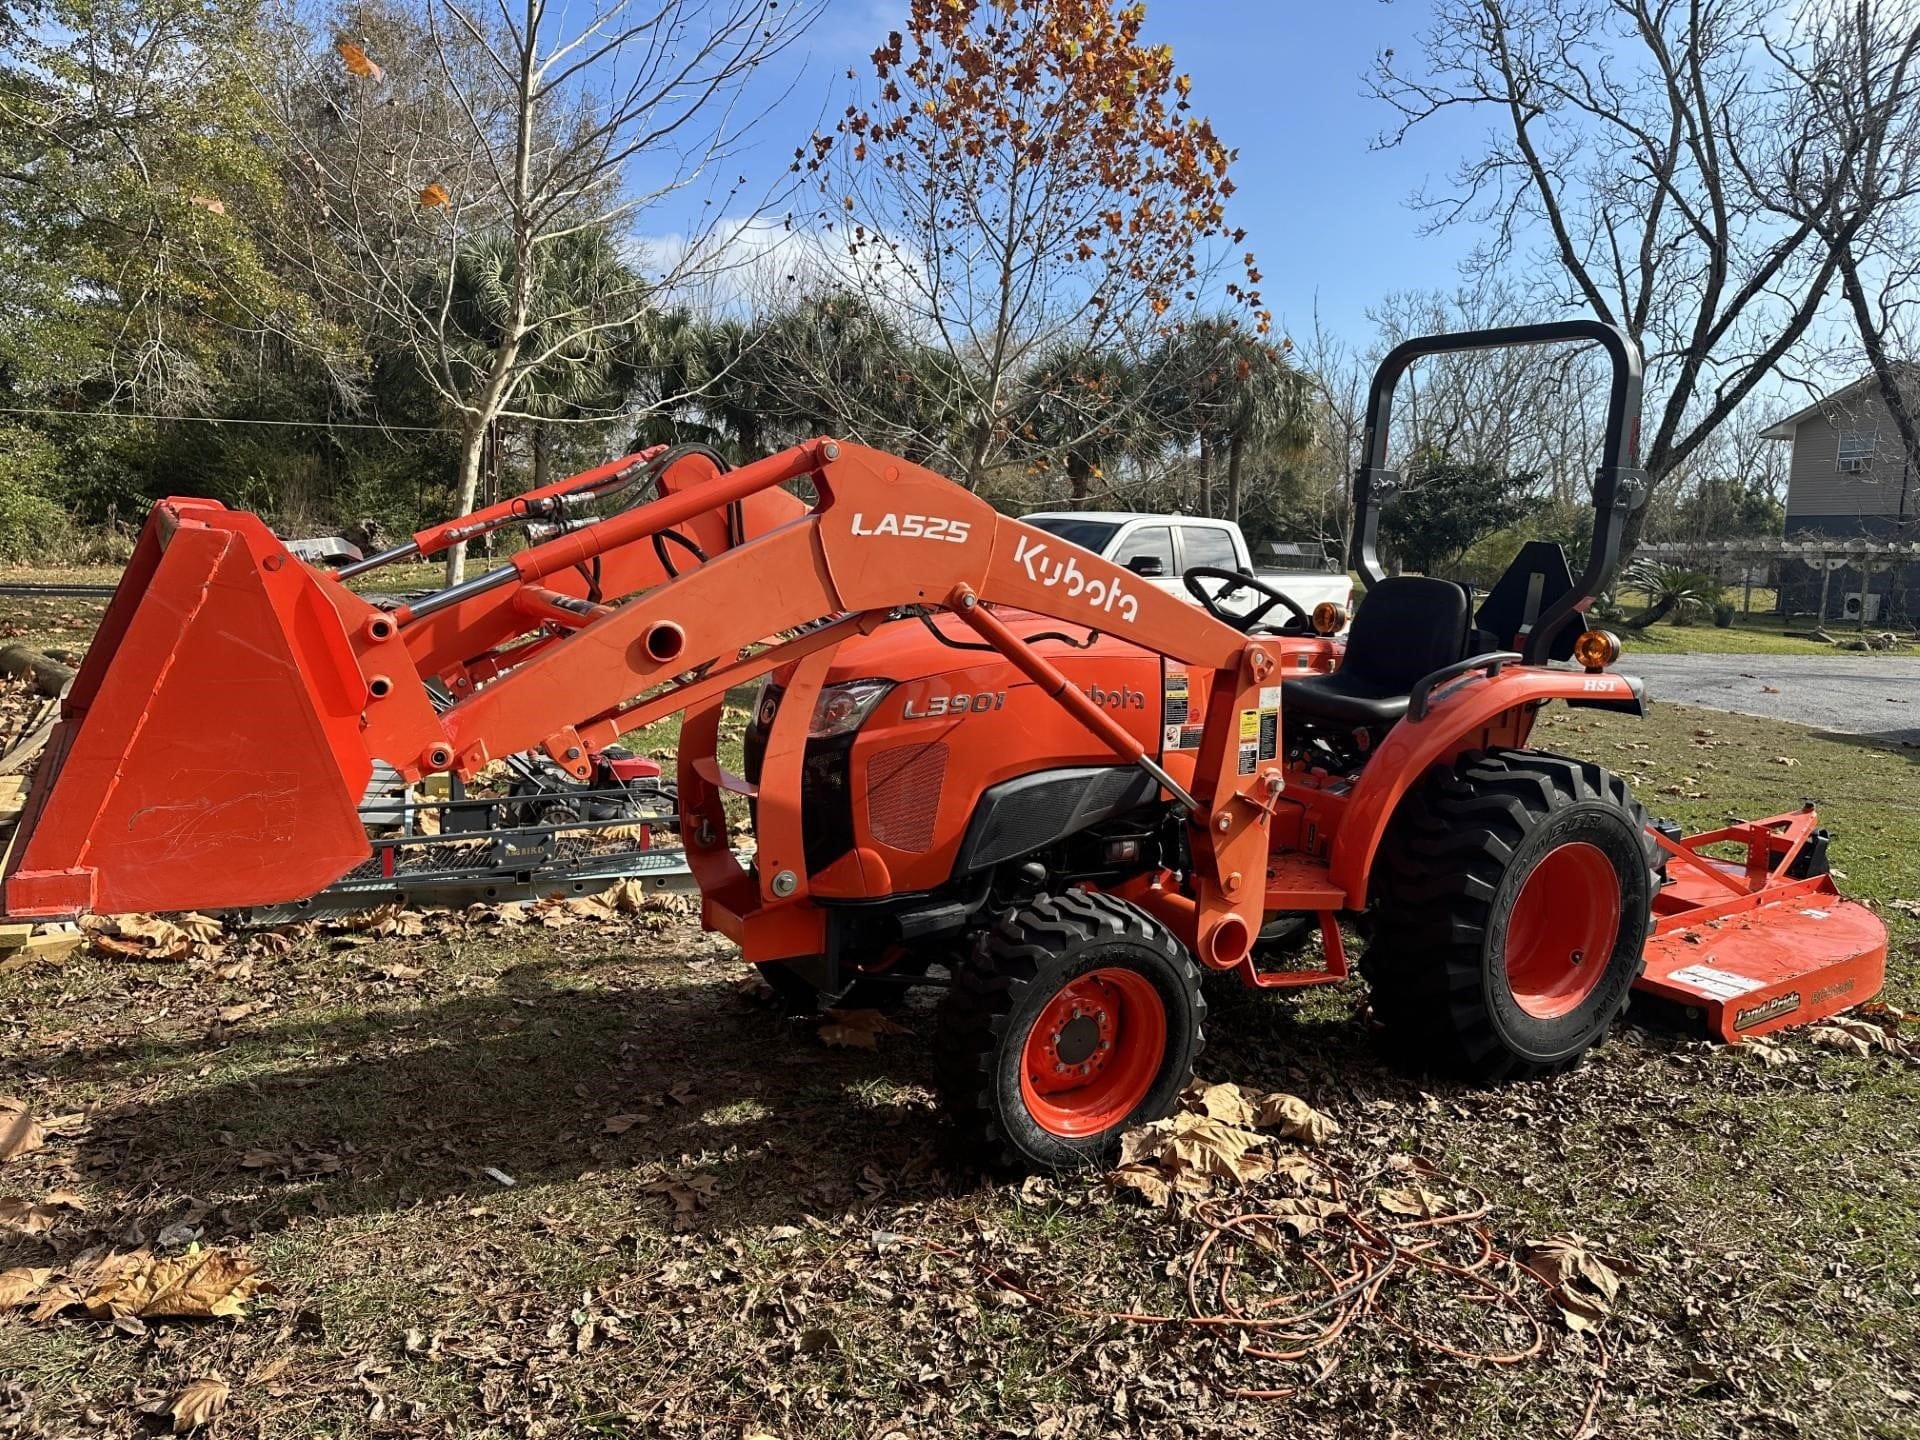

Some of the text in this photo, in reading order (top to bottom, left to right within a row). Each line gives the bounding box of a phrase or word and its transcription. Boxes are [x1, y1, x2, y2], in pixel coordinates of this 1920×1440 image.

[851, 513, 972, 544] LA525
[1013, 535, 1138, 623] Kubota
[1083, 682, 1145, 710] bota
[1583, 679, 1616, 692] HST
[903, 691, 1007, 720] L3901
[1737, 1003, 1767, 1021] Land
[1769, 991, 1800, 1009] Pride
